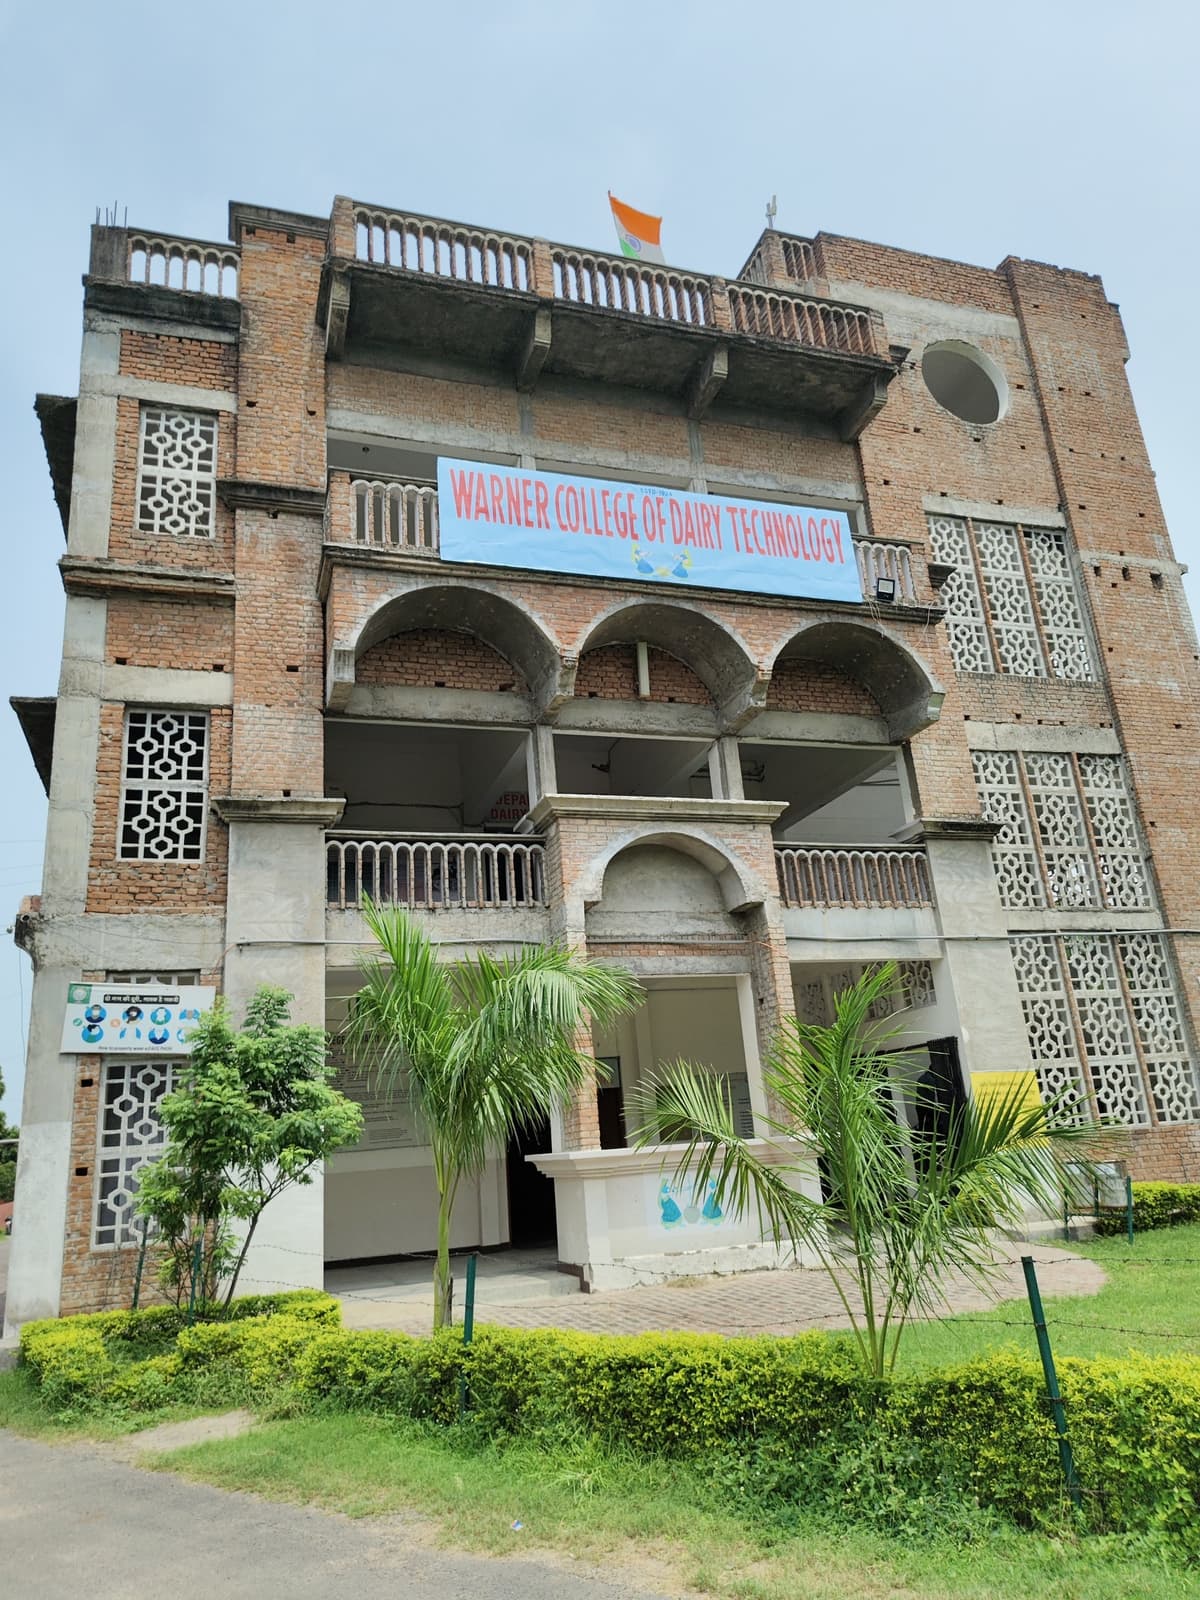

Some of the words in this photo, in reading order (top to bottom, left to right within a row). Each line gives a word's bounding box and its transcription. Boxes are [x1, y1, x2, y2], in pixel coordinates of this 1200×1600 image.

[450, 468, 551, 530] WARNER
[555, 484, 640, 541] COLLEGE
[642, 495, 667, 544] OF
[669, 497, 723, 551] DAIRY
[726, 506, 845, 564] TECHNOLOGY
